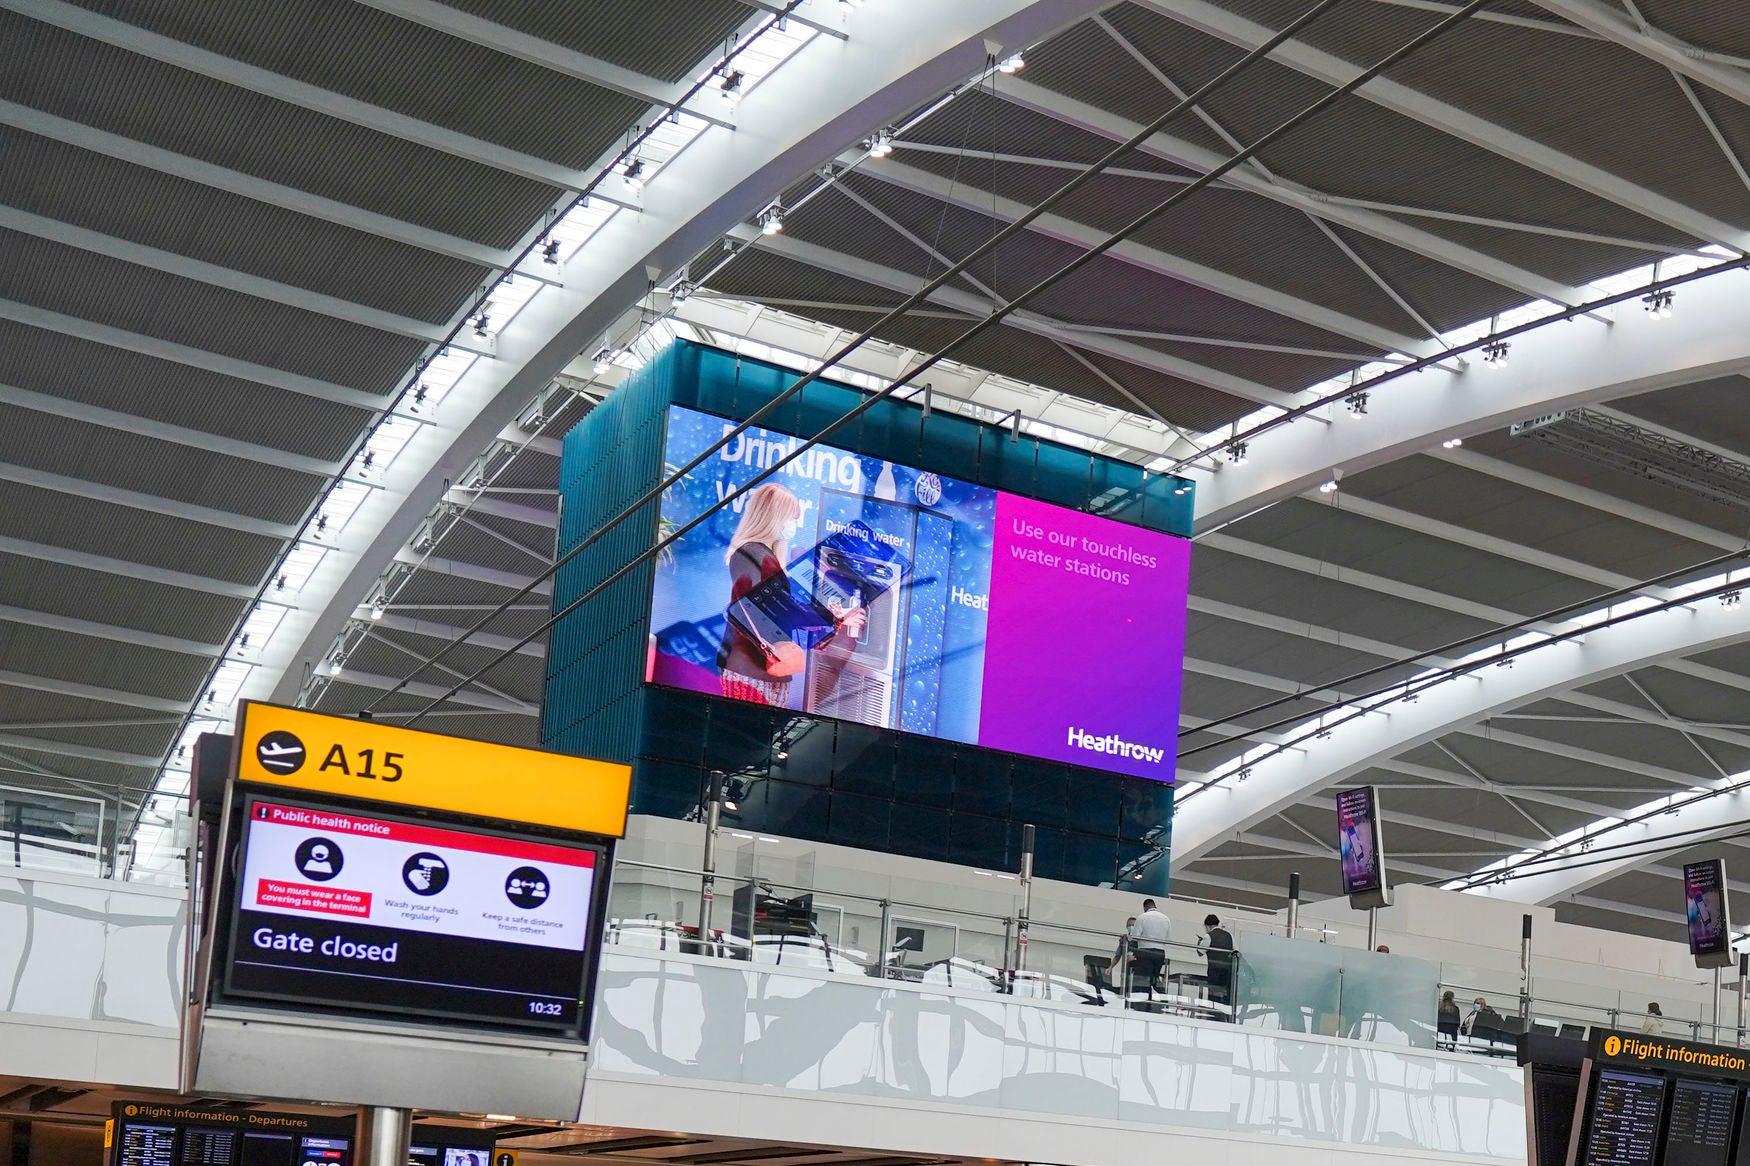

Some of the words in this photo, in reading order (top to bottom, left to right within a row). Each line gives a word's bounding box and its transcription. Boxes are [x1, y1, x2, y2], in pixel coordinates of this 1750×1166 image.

[720, 421, 862, 494] Drinking
[825, 519, 869, 541] Drinking
[872, 527, 905, 547] water
[1013, 518, 1044, 540] Use
[1048, 530, 1077, 548] our
[1081, 535, 1158, 569] touchless
[1010, 544, 1061, 568] water
[1065, 555, 1131, 586] stations
[951, 585, 988, 611] Heat
[1067, 726, 1165, 764] Heathrow
[319, 743, 404, 783] A15
[273, 809, 310, 824] Public
[312, 814, 351, 829] health
[353, 821, 391, 835] notice
[261, 893, 300, 907] covering
[302, 897, 311, 905] in
[313, 899, 328, 908] the
[329, 901, 366, 913] terminal
[267, 884, 286, 893] You
[286, 886, 310, 897] must
[311, 890, 333, 899] wear
[342, 893, 361, 903] face
[384, 899, 409, 910] Wash
[410, 904, 431, 913] your
[433, 905, 459, 915] hands
[401, 911, 440, 923] regularly
[482, 912, 503, 922] Keep
[512, 916, 528, 924] safe
[530, 917, 564, 928] distance
[498, 923, 518, 932] from
[520, 925, 545, 936] others
[253, 928, 314, 953] Gate
[320, 935, 398, 963] closed
[529, 1001, 562, 1015] 10:32
[1622, 1038, 1663, 1059] Flight
[1665, 1044, 1746, 1071] information
[139, 1106, 172, 1118] Flight
[174, 1108, 240, 1122] information
[249, 1114, 308, 1128] Departures
